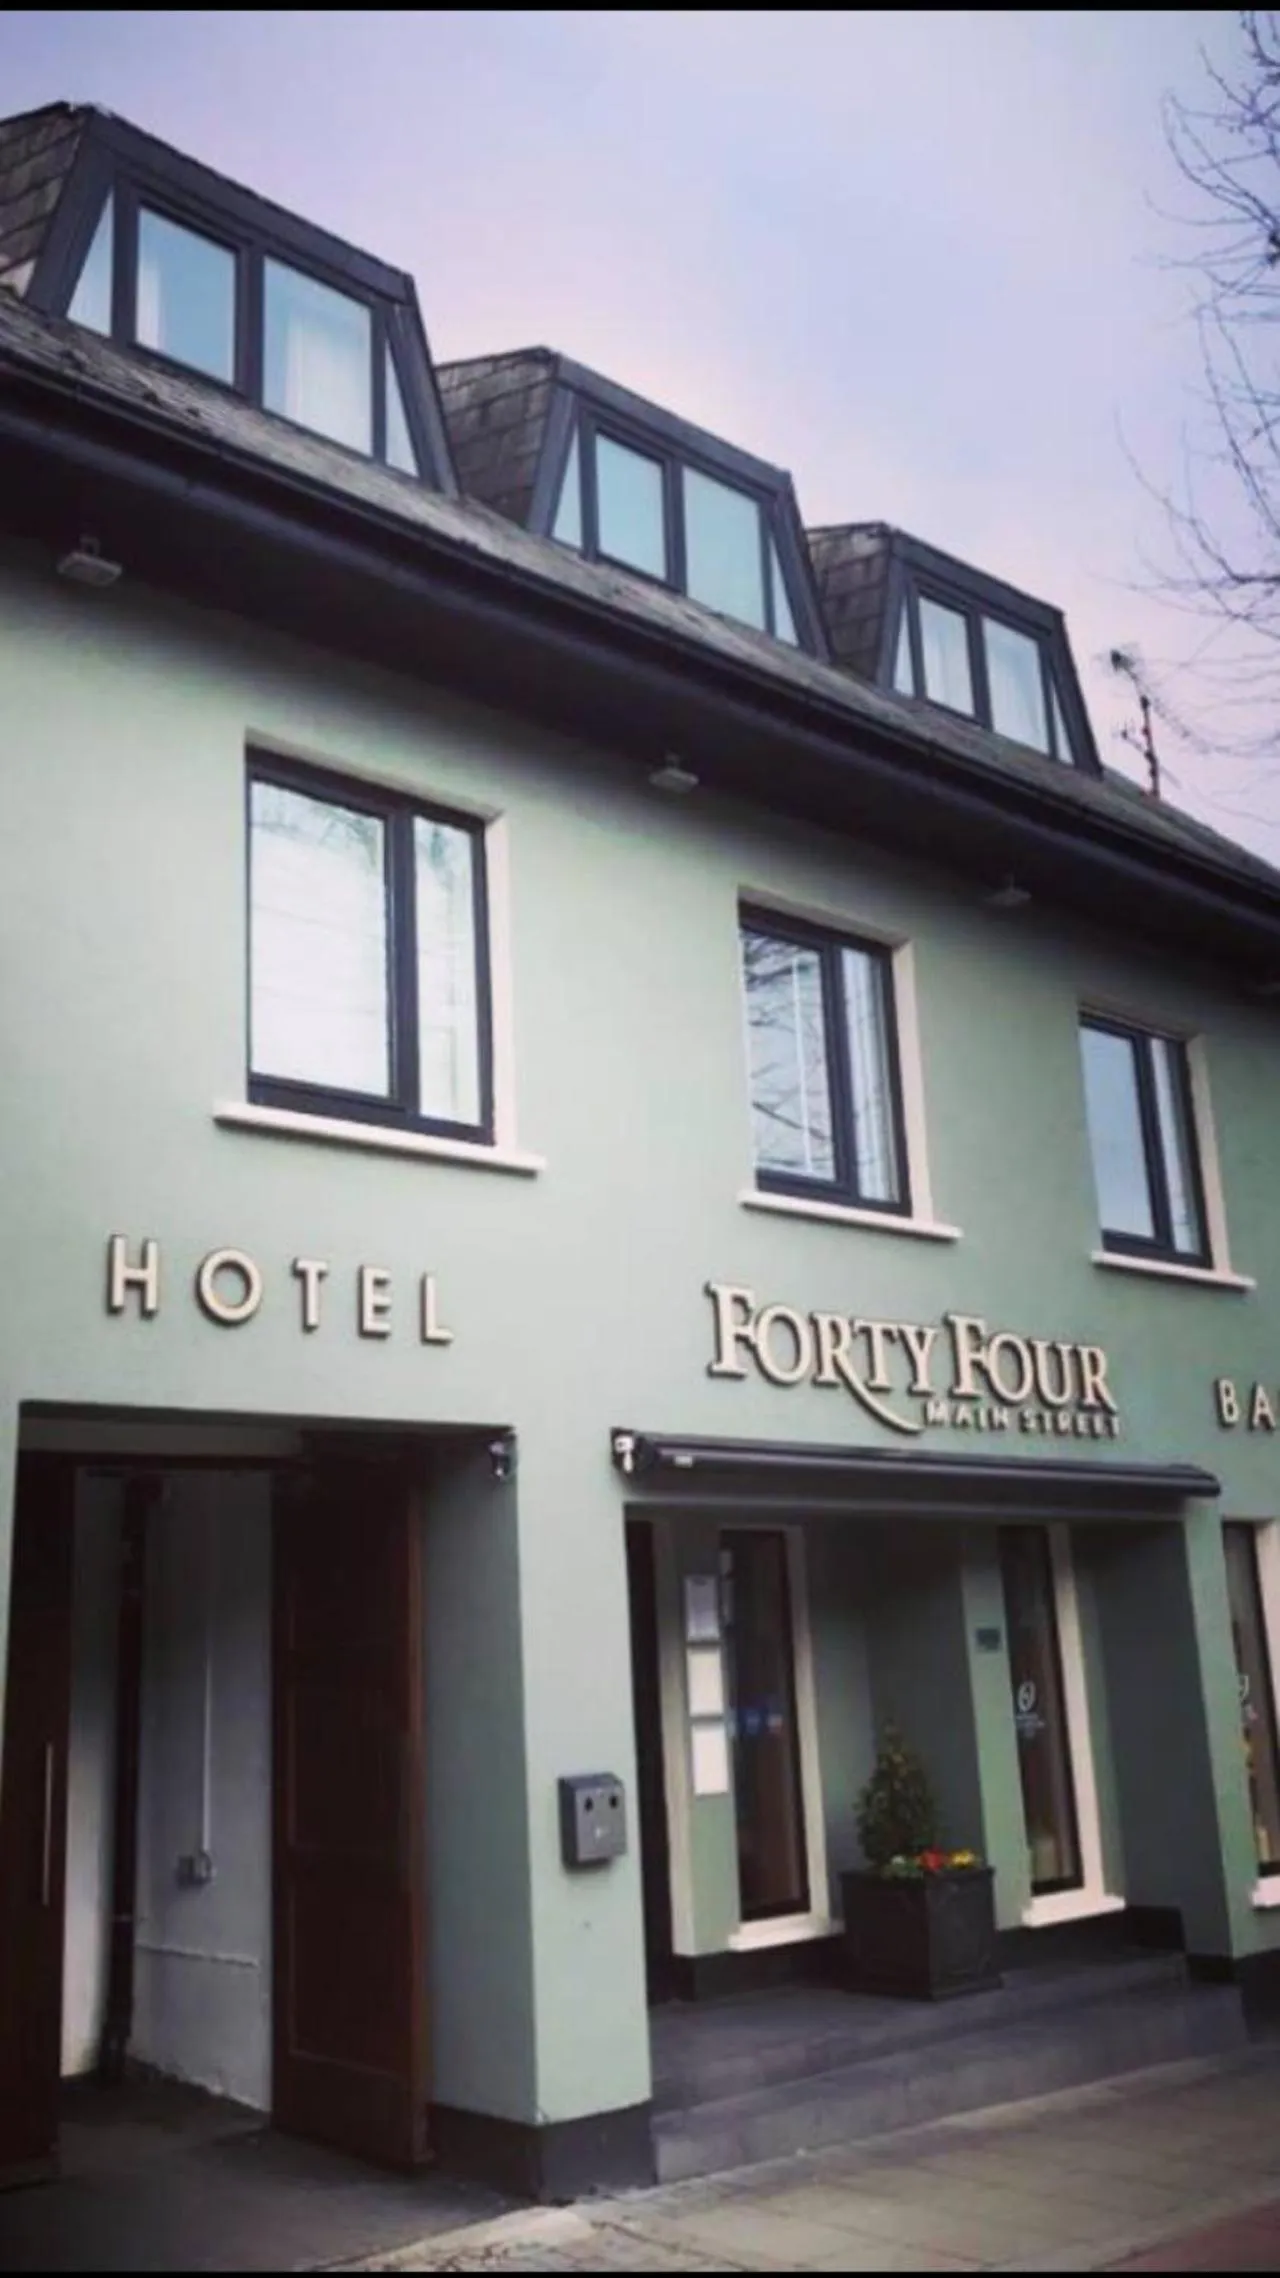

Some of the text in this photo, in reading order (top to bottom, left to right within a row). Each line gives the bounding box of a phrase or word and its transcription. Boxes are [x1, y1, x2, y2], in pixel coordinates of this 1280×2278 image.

[107, 1233, 454, 1345] HOTEL
[704, 1282, 1118, 1433] FORTY FOUR
[924, 1400, 1121, 1440] MAIN STREET
[1212, 1377, 1280, 1436] BA
